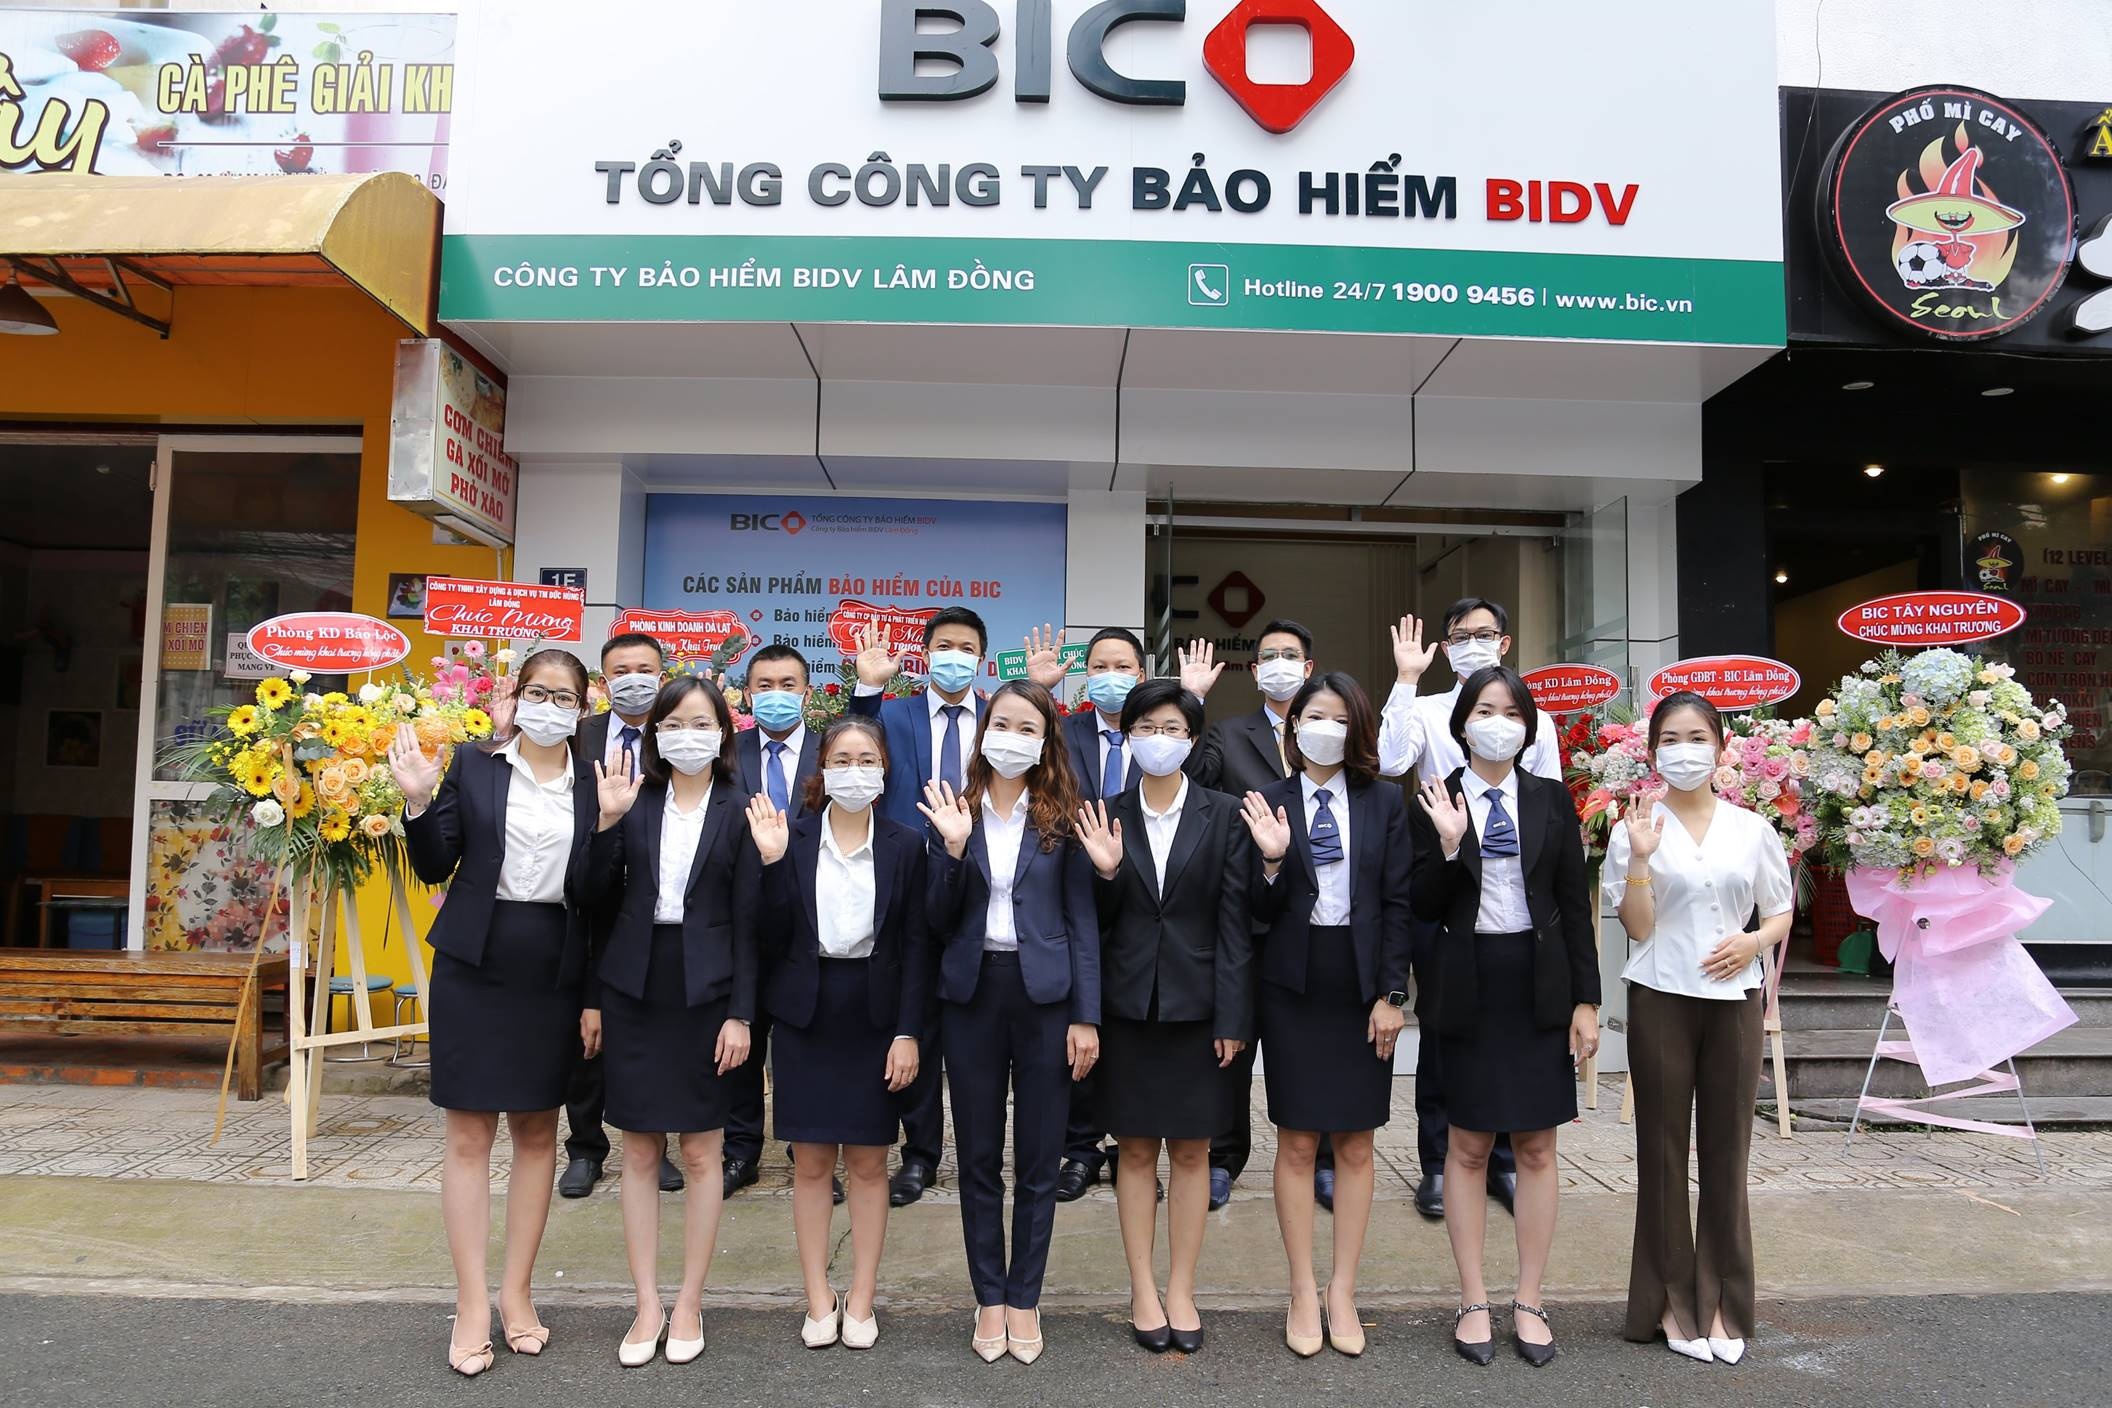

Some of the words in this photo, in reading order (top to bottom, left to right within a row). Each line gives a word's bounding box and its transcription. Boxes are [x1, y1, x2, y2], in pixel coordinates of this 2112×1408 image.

[879, 0, 1186, 106] BIC
[158, 54, 208, 114] CÀ
[224, 54, 299, 114] PHÊ
[312, 50, 392, 114] GIẢI
[401, 63, 452, 114] KH
[1889, 98, 1935, 134] PHỐ
[1944, 100, 1971, 119] MÌ
[1979, 110, 2023, 143] CAY
[595, 139, 782, 206] TỔNG
[808, 151, 1000, 208] CÔNG
[1021, 164, 1107, 209] TY
[1132, 153, 1271, 213] BẢO
[1299, 153, 1457, 219] HIỂM
[1486, 178, 1639, 225] BIDV
[493, 261, 578, 288] CÔNG
[589, 266, 628, 288] TY
[638, 260, 700, 288] BẢO
[709, 257, 781, 289] HIỂM
[793, 267, 860, 290] BIDV
[873, 263, 937, 290] LÂM
[948, 259, 1035, 292] ĐỒNG
[1244, 277, 1324, 299] Hotline
[1332, 280, 1386, 301] 24/7
[1392, 282, 1459, 303] 1900
[1467, 285, 1535, 306] 9456
[1555, 292, 1692, 313] www.bic.vn
[1910, 292, 2012, 320] Seoul
[444, 404, 473, 442] CƠM
[446, 438, 464, 468] GÀ
[467, 451, 488, 484] XỐI
[450, 472, 478, 507] PHỞ
[730, 513, 780, 531] BIC
[429, 581, 447, 591] CÔNG
[448, 583, 456, 591] TY
[683, 572, 719, 594] CÁC
[726, 572, 761, 594] SẢN
[768, 569, 822, 595] PHẨM
[828, 573, 865, 595] BẢO
[872, 571, 919, 597] HIỂM
[926, 575, 963, 598] CỦA
[970, 580, 1001, 598] BIC
[774, 607, 799, 621] Bảo
[1862, 607, 1888, 619] BIC
[1893, 602, 1925, 618] TÂY
[1929, 599, 1998, 616] NGUYÊN
[429, 604, 494, 623] Chúc
[501, 609, 575, 640] Mừng
[451, 623, 485, 636] KHAI
[487, 625, 541, 639] TRƯƠNG
[629, 618, 657, 632] PHÒNG
[657, 620, 676, 632] KINH
[677, 621, 704, 633] DOANH
[717, 622, 732, 636] LẠT
[1859, 621, 1888, 637] CHÚC
[1890, 620, 1923, 636] MỪNG
[1925, 621, 1951, 635] KHAI
[1953, 620, 2001, 633] TRƯƠNG
[266, 626, 314, 641] Phòng
[318, 627, 340, 639] KD
[375, 629, 397, 642] Lộc
[773, 633, 799, 648] Bảo
[262, 643, 293, 658] Chúc
[893, 641, 922, 652] TRƯƠN
[238, 663, 263, 671] MANG
[1004, 655, 1024, 666] BIDV
[1526, 679, 1543, 692] òng
[1545, 678, 1559, 689] KD
[1561, 677, 1582, 688] Lâm
[1585, 673, 1612, 687] Đồng
[1661, 671, 1689, 686] Phòng
[1691, 671, 1717, 683] GĐBT
[1724, 670, 1741, 682] BIC
[1744, 669, 1764, 682] Lâm
[1766, 667, 1790, 683] Đồng
